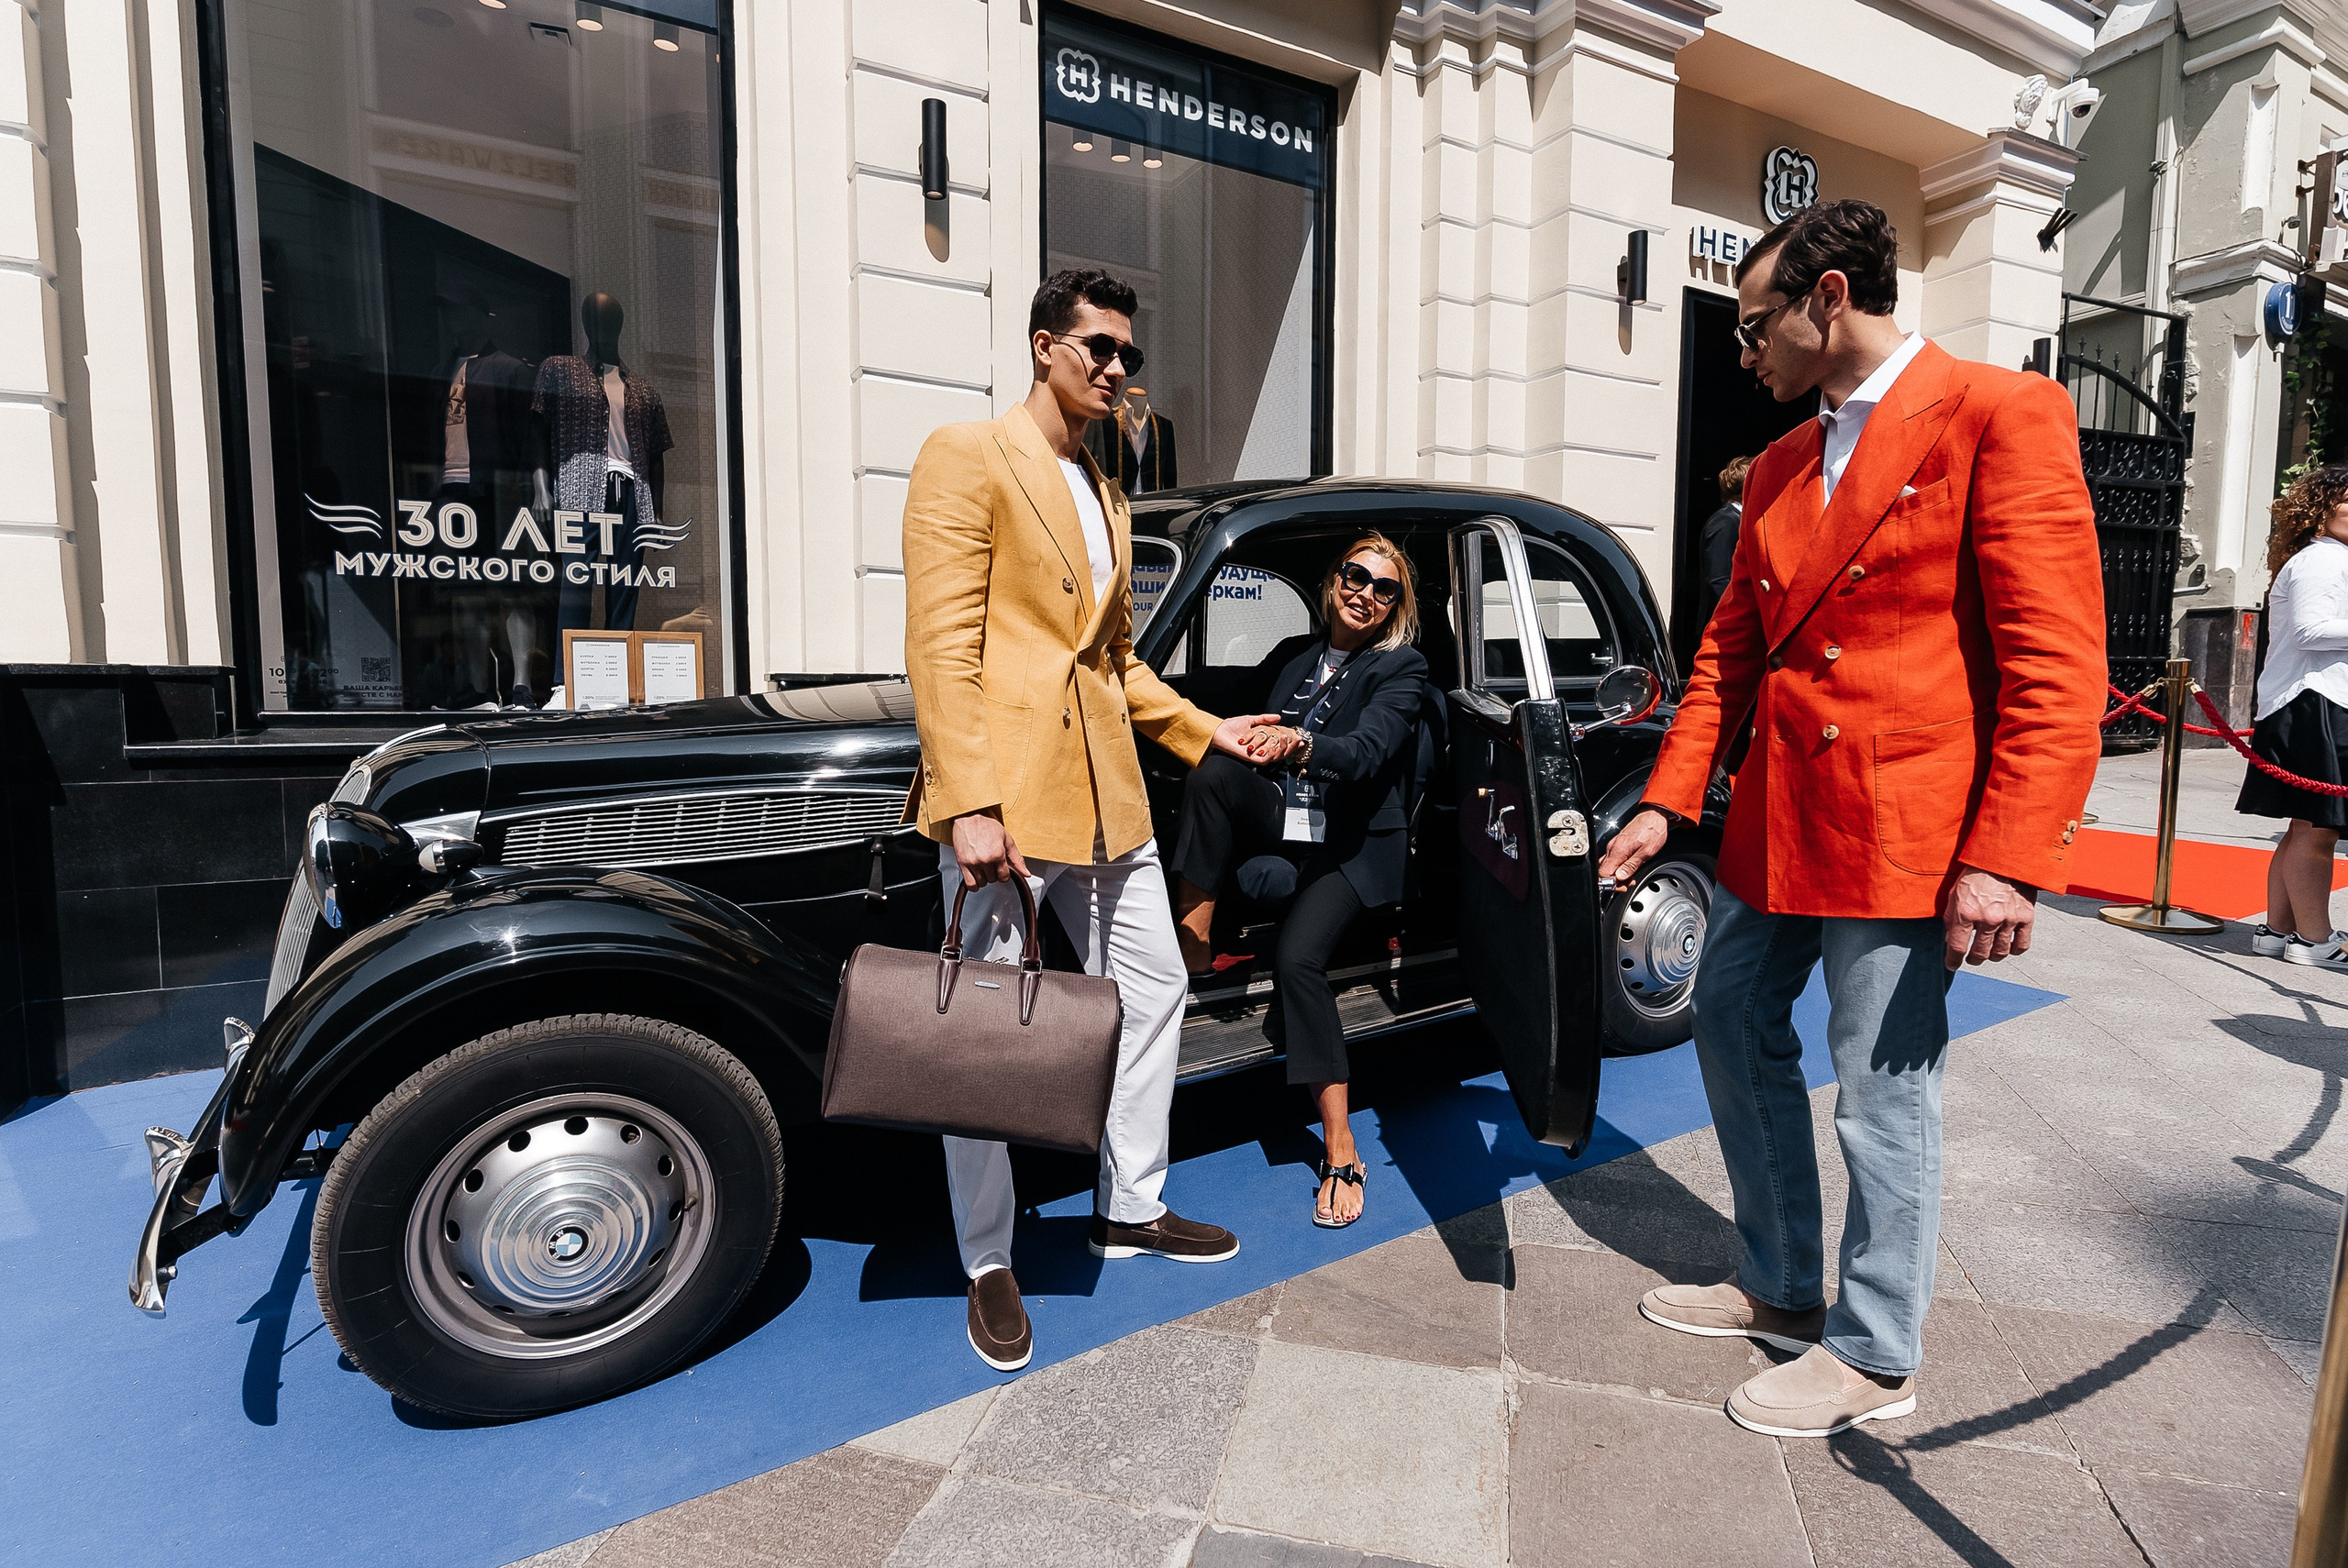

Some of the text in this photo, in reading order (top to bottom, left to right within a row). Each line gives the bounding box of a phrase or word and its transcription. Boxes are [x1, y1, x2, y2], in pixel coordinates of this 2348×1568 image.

[1069, 63, 1312, 153] H HENDERSON
[1779, 171, 1806, 208] H
[398, 499, 624, 556] 30 ЛЕТ
[335, 551, 677, 588] МУЖСКОГО СТИЛЯ
[1219, 566, 1276, 581] удуще
[1133, 602, 1153, 612] OUR
[1208, 584, 1263, 601] еркам!
[549, 1229, 565, 1260] BMW
